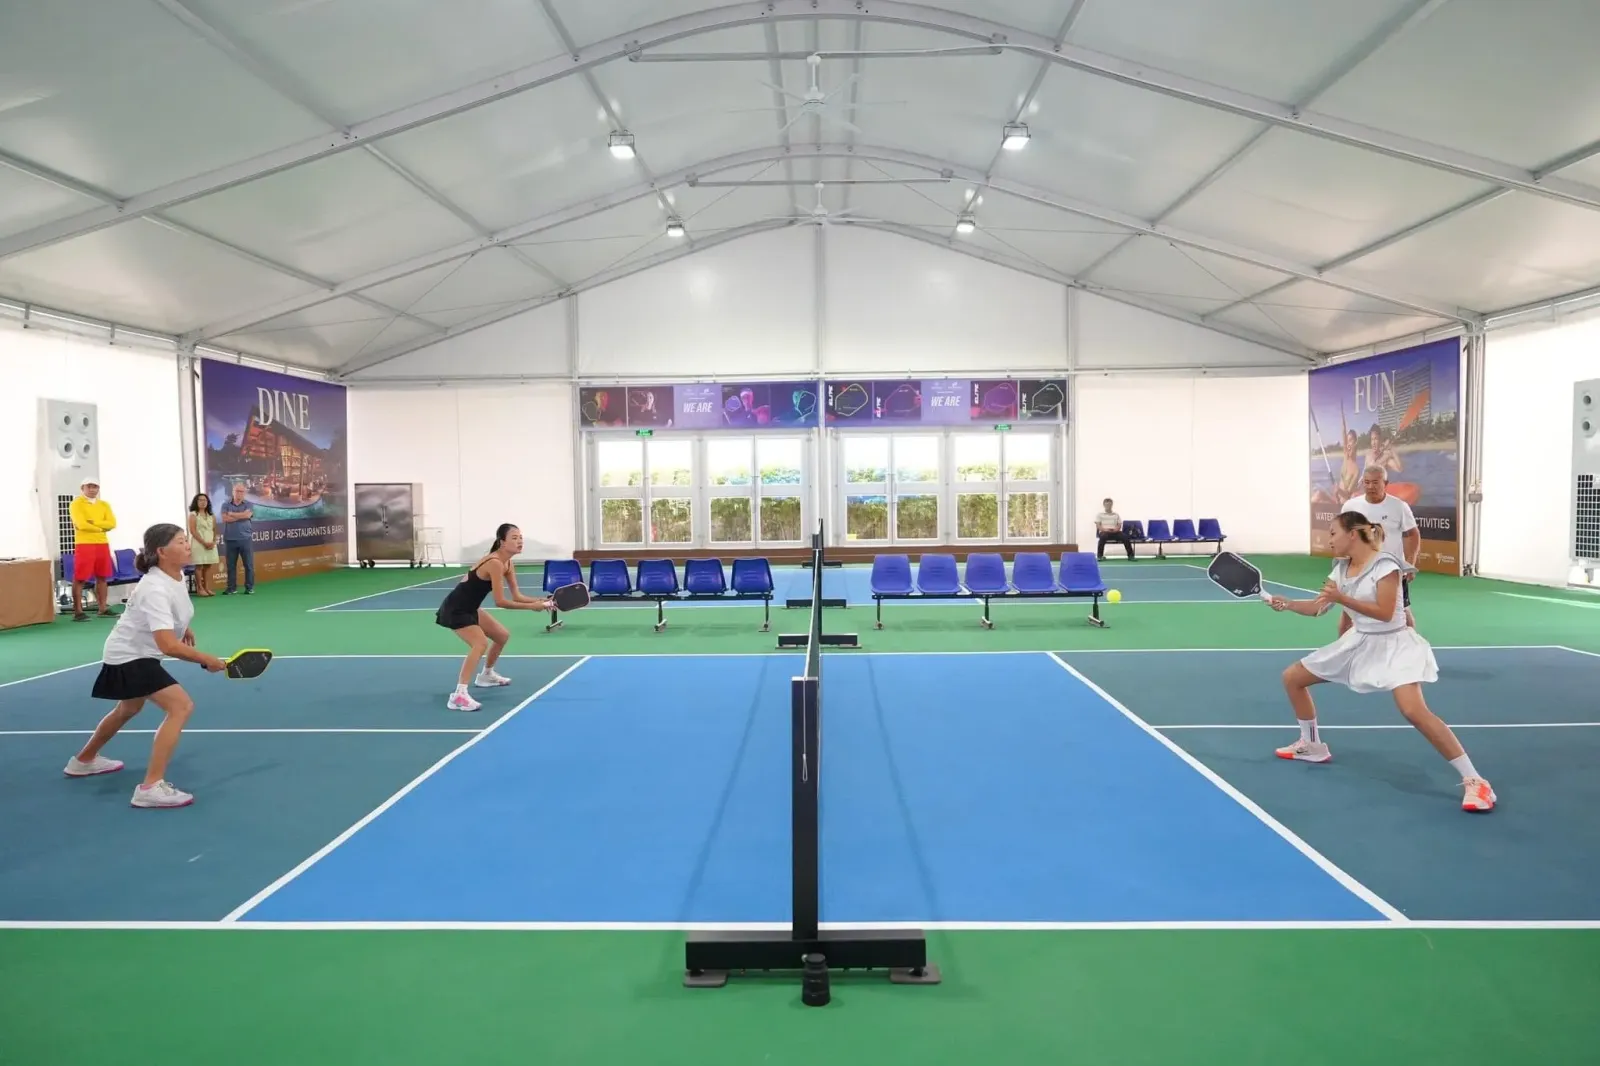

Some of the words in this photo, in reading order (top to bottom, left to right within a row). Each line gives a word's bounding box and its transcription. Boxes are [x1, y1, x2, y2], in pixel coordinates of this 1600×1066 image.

[1353, 370, 1396, 414] FUN
[256, 386, 310, 430] DINE
[683, 402, 697, 413] WE
[696, 402, 713, 413] ARE
[931, 396, 944, 407] WE
[944, 395, 961, 407] ARE
[1415, 516, 1450, 529] CTIVITIES
[251, 530, 270, 542] CLUB
[286, 525, 326, 539] RESTAURANTS
